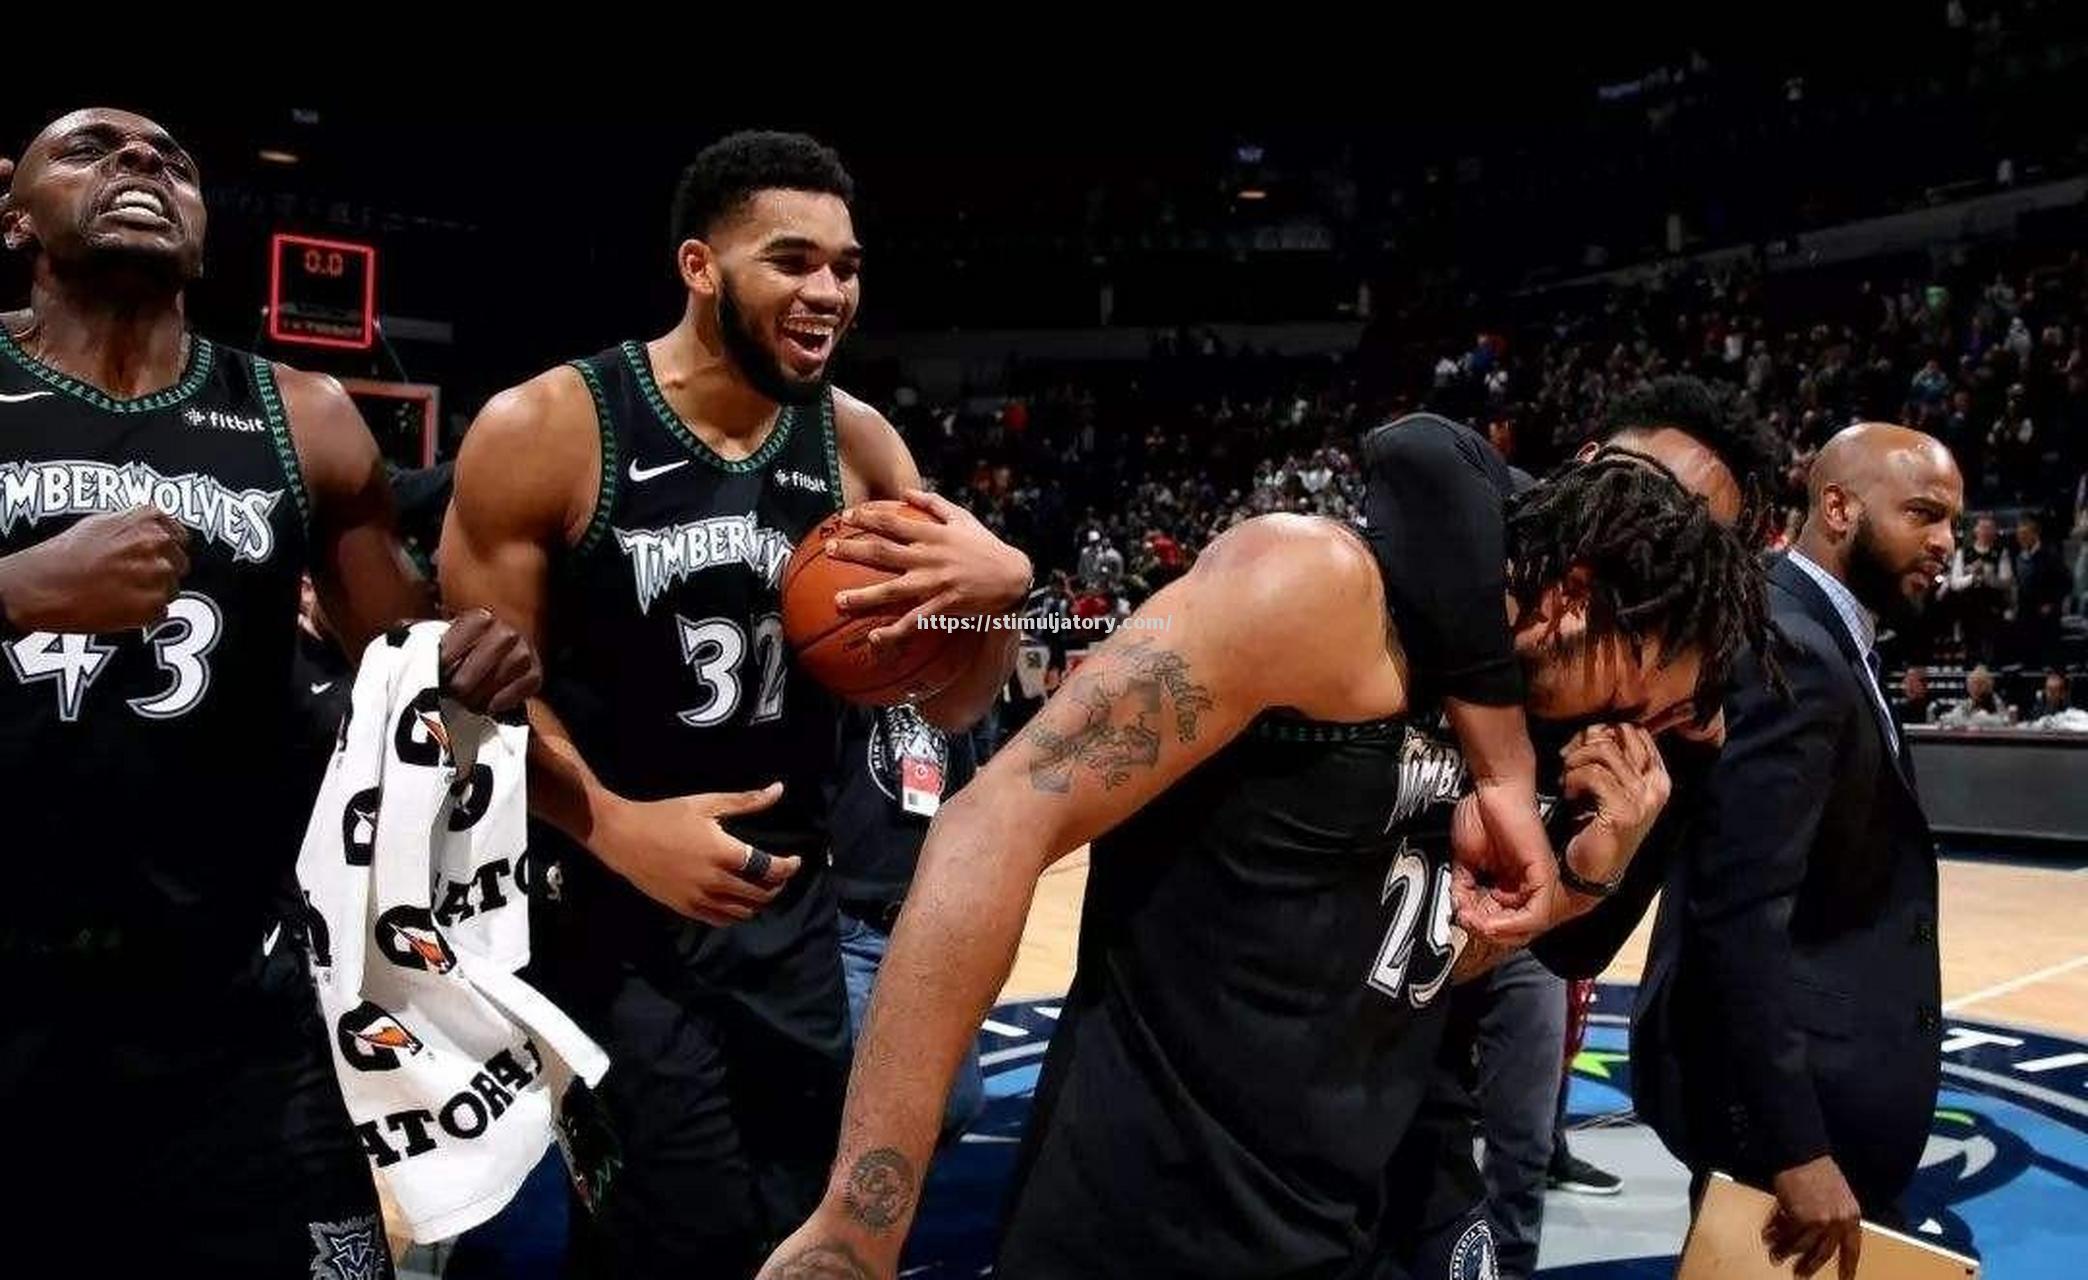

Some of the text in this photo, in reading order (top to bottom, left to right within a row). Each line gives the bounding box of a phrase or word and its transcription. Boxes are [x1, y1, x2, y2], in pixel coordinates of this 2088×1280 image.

[209, 411, 266, 432] fitbit
[3, 591, 222, 722] 43
[676, 613, 786, 727] 32
[1368, 836, 1468, 1008] 25
[354, 1036, 543, 1169] ATORA
